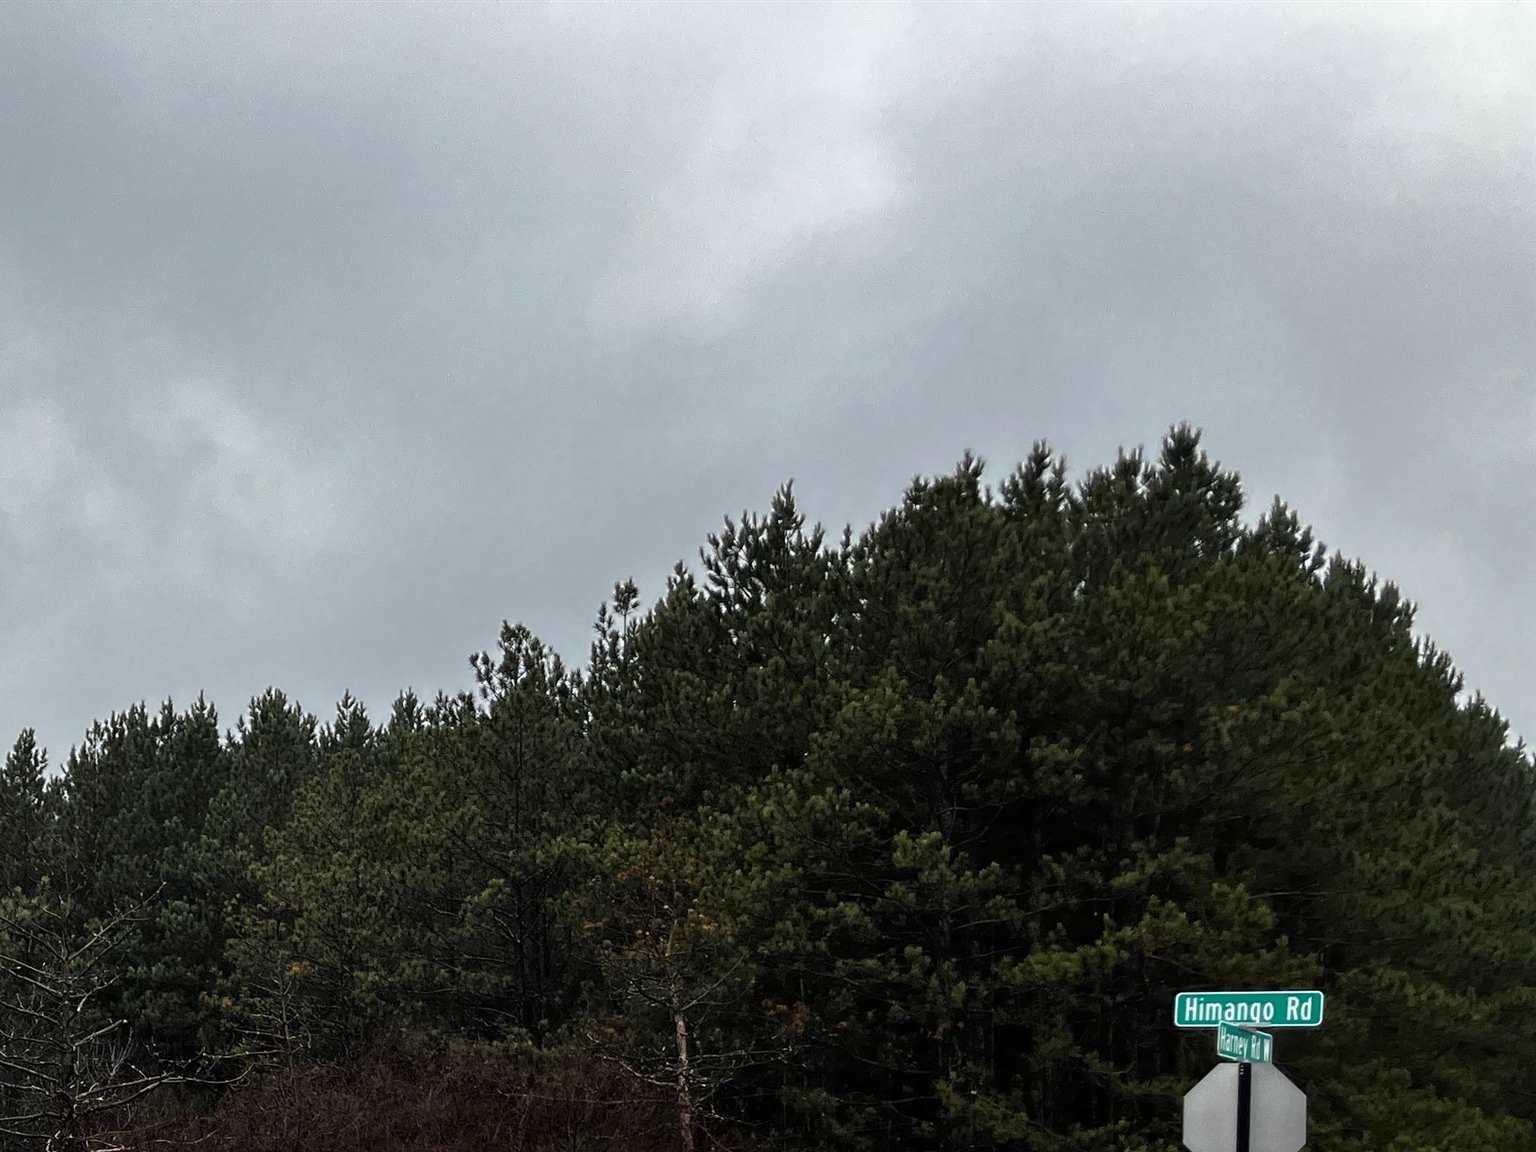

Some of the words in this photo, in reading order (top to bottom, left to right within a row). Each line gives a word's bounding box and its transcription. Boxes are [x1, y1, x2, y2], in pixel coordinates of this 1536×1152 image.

[1184, 997, 1274, 1023] Himango
[1287, 996, 1313, 1021] Rd
[1221, 1028, 1249, 1058] Harney
[1251, 1034, 1261, 1060] Rd
